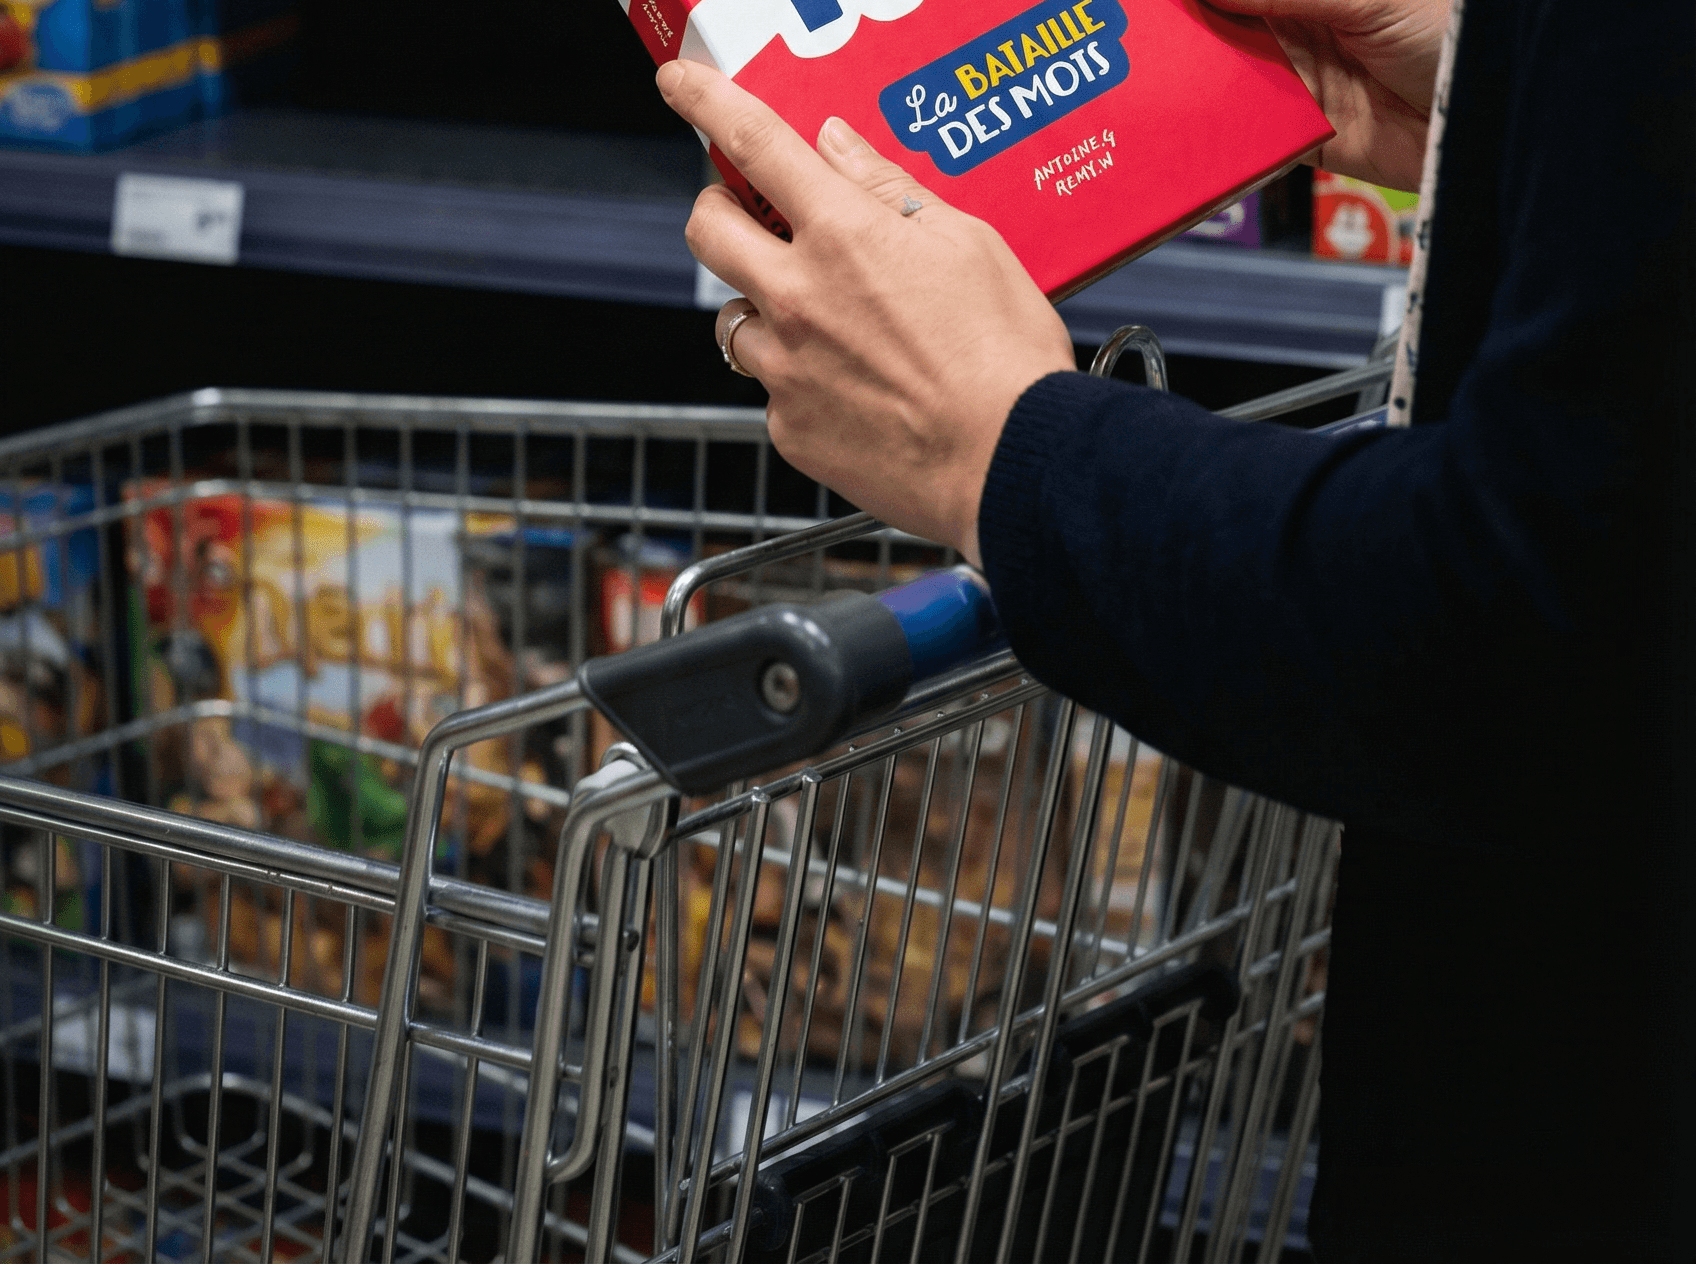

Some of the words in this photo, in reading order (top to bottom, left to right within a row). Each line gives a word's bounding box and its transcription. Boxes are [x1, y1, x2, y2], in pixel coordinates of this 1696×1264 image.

[905, 84, 957, 133] La
[937, 96, 1012, 159] DES
[1009, 41, 1110, 119] MOTS
[1033, 129, 1116, 191] ANTOINE.G
[1055, 152, 1114, 196] REMY.W
